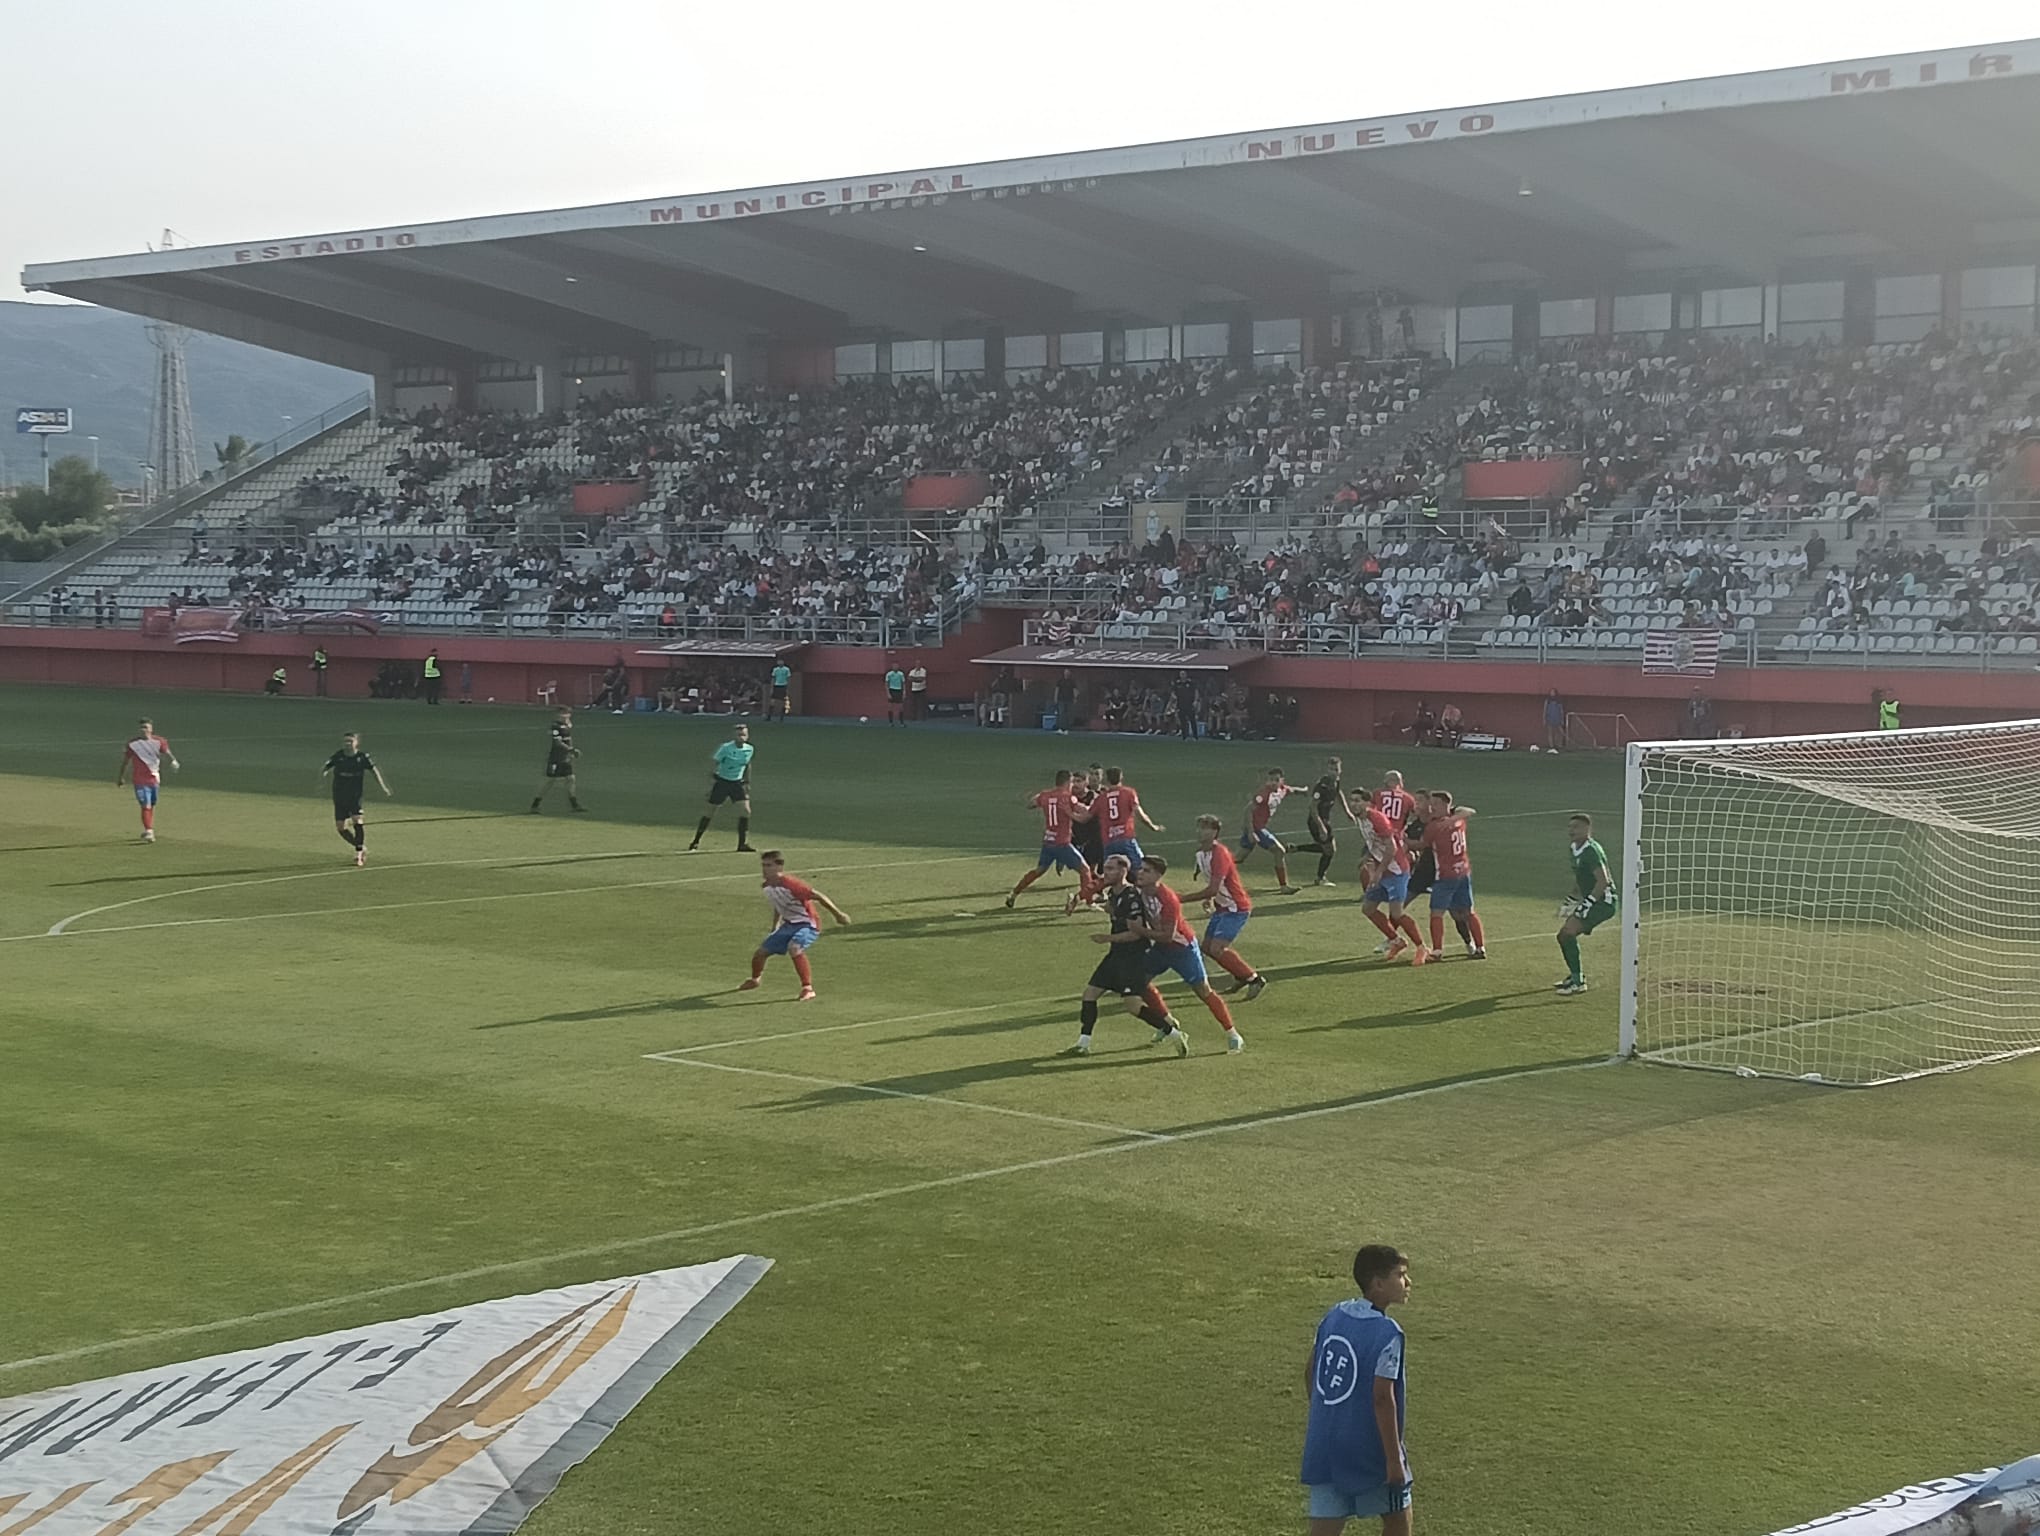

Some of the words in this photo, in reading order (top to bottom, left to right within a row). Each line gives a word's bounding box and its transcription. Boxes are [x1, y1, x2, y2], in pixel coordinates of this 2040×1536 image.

[234, 233, 416, 263] ESTADIO
[650, 174, 973, 222] MUNICIPAL
[1247, 114, 1494, 159] NUEVO
[1048, 804, 1058, 827] 11
[1108, 797, 1119, 819] 5
[1381, 796, 1402, 819] 20
[1451, 830, 1467, 856] 24
